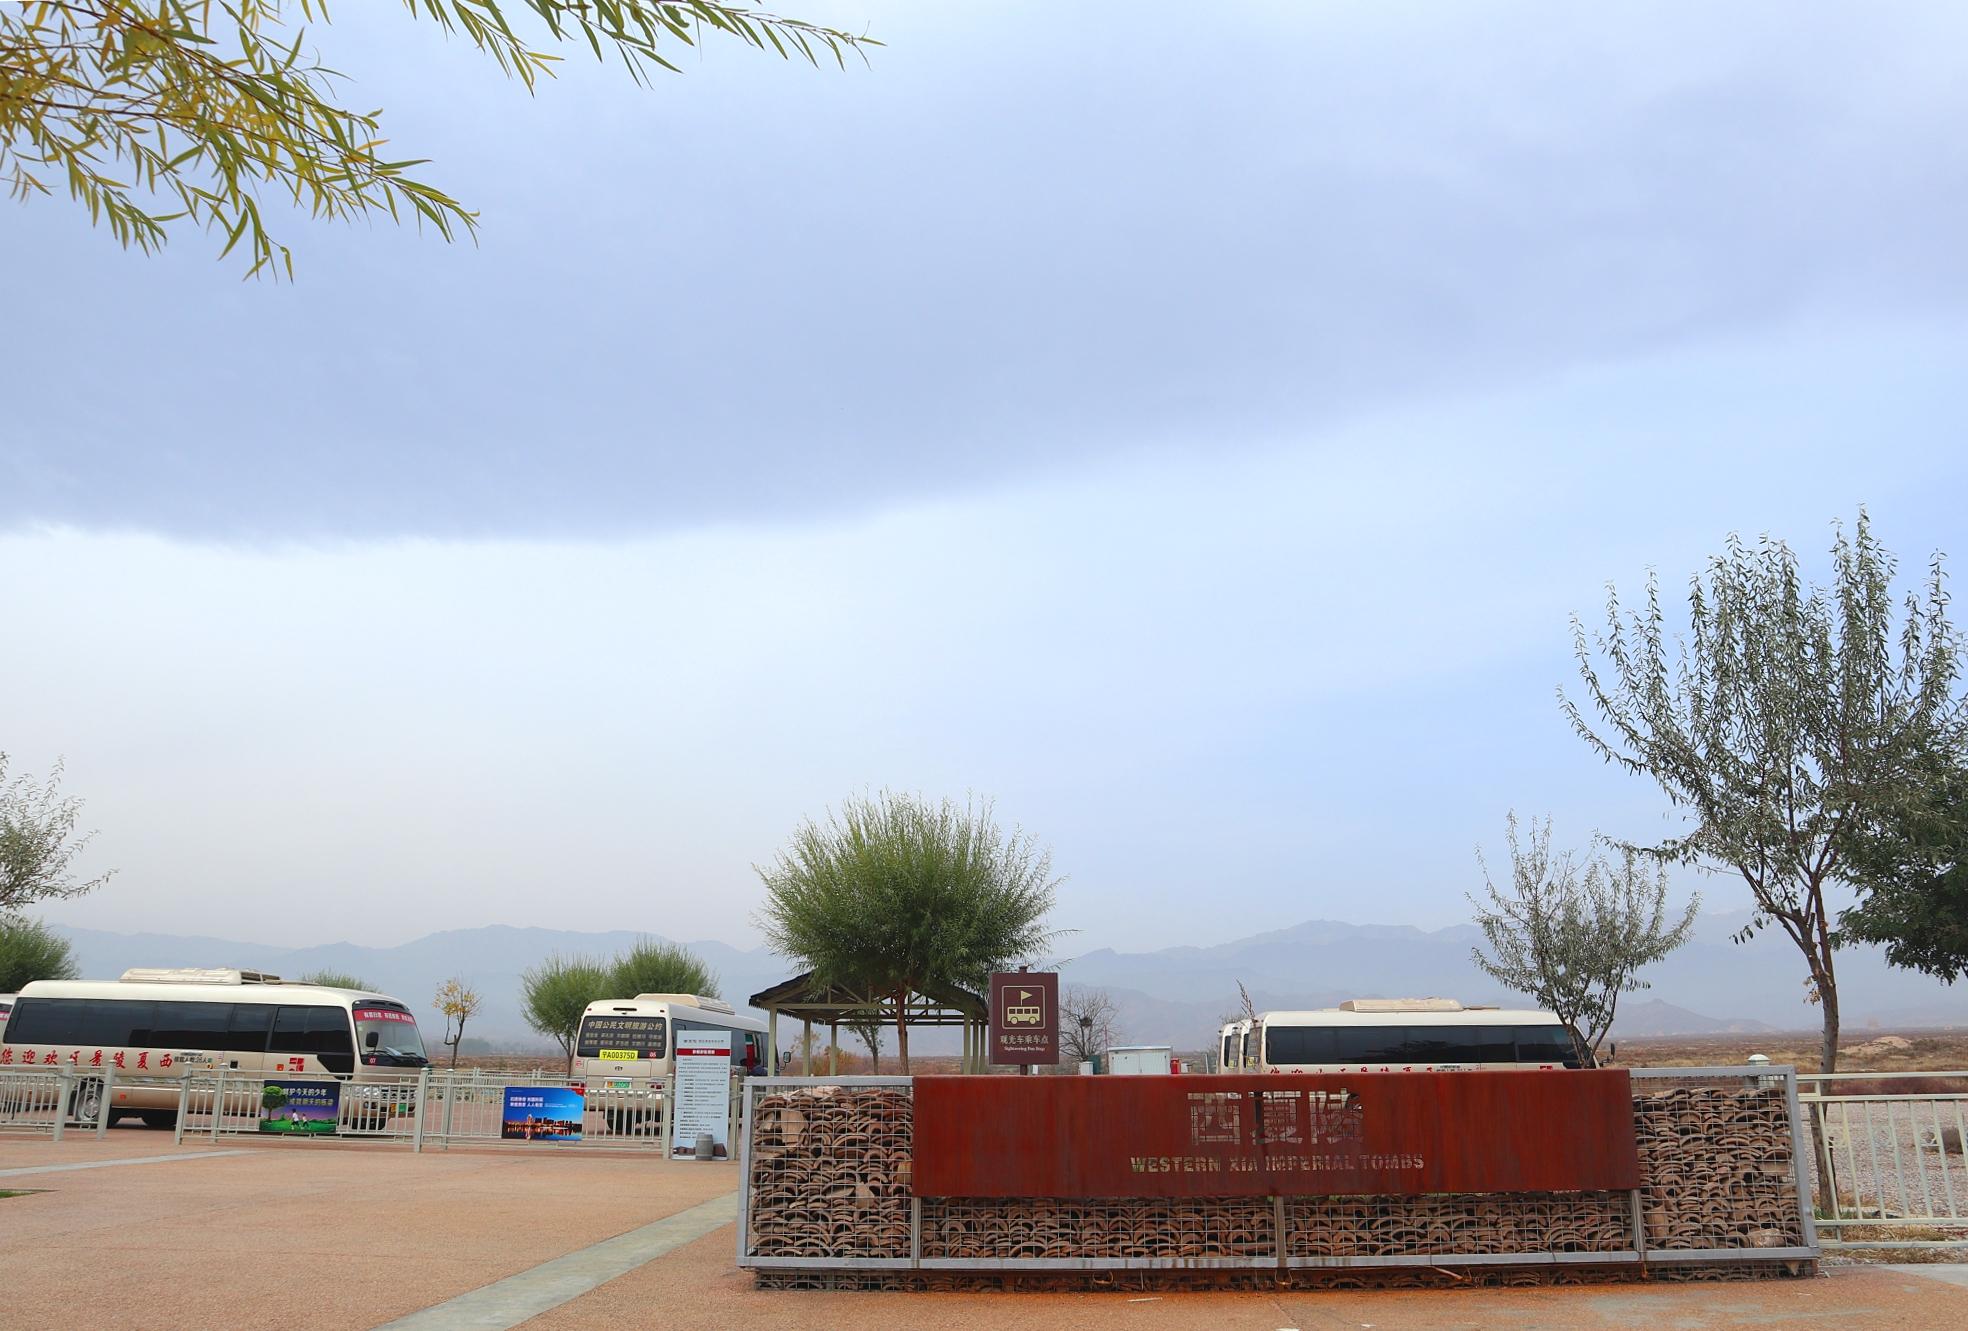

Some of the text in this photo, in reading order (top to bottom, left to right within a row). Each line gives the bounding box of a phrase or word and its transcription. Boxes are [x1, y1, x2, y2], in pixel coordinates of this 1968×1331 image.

[588, 1021, 663, 1031] 中国公民文明旅游公约
[1130, 1153, 1424, 1173] WESTERN XIA IMPERIAL TOMBS
